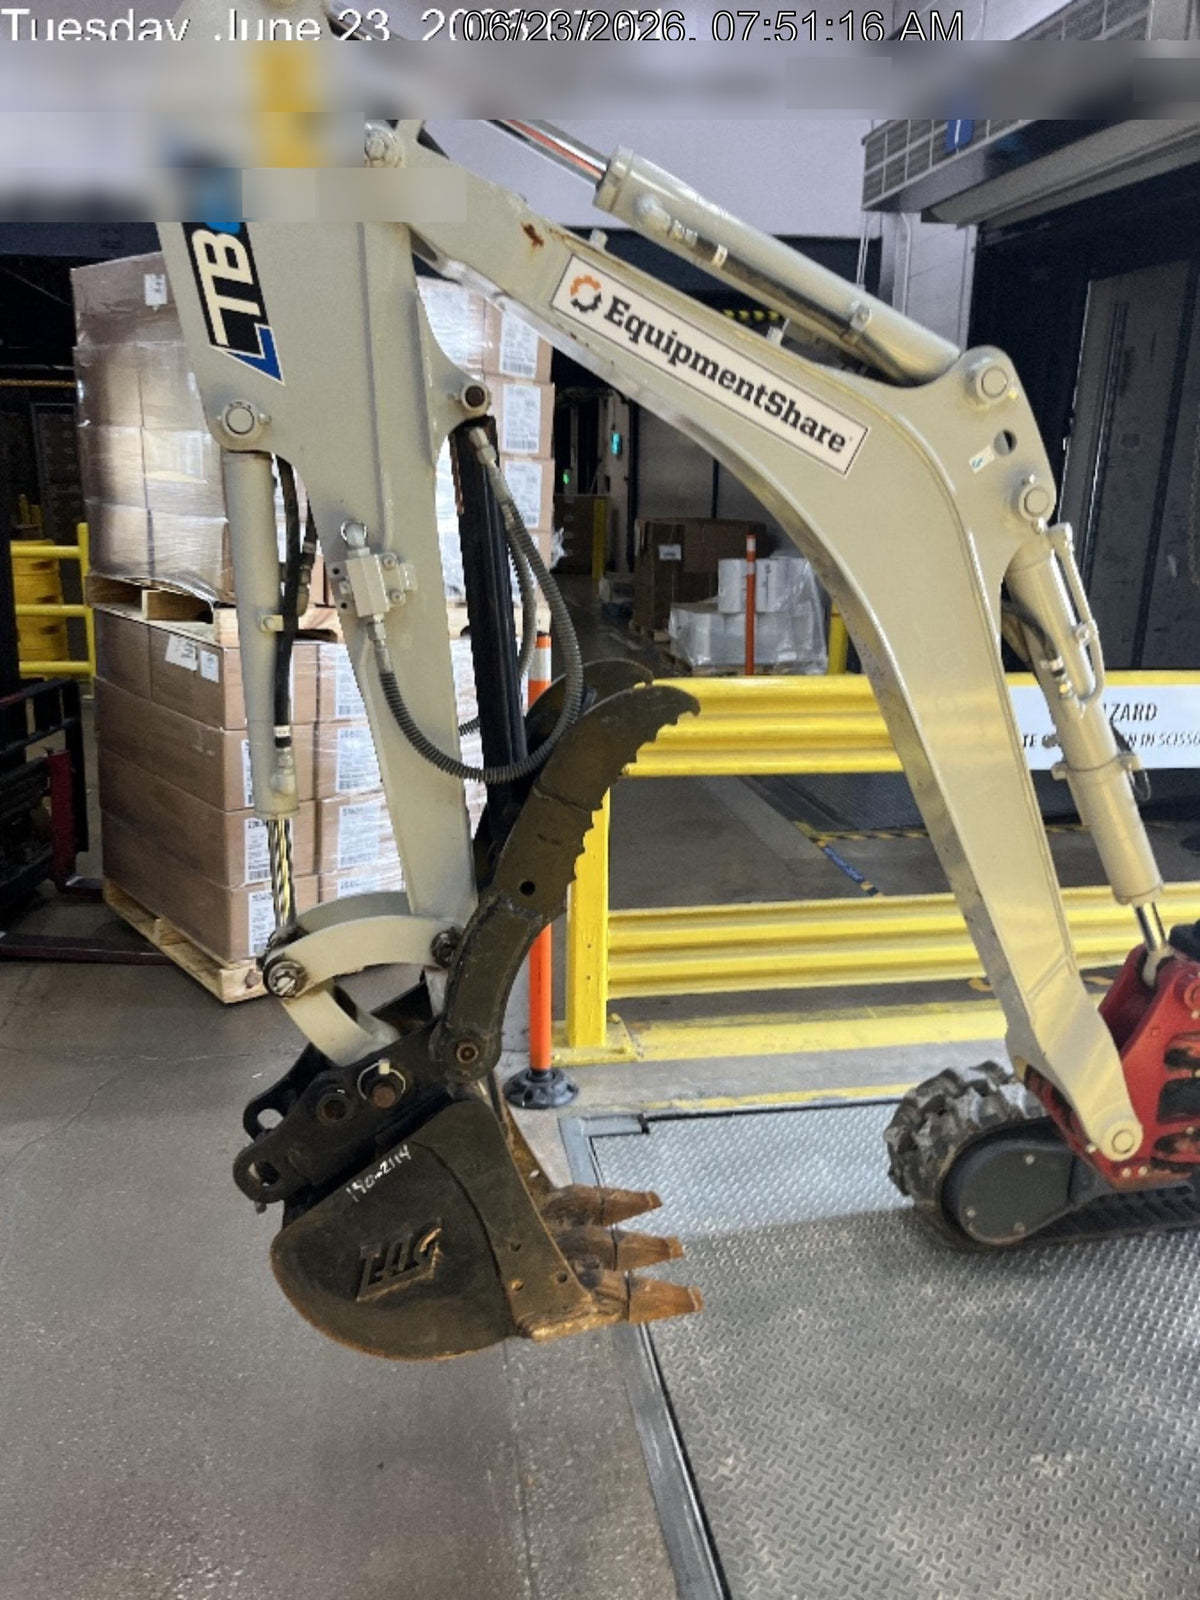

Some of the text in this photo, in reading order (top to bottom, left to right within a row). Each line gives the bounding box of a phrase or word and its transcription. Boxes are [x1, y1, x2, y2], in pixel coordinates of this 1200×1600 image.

[192, 222, 261, 347] TB
[603, 296, 845, 453] EquipmentShare
[1103, 702, 1158, 721] ZARD
